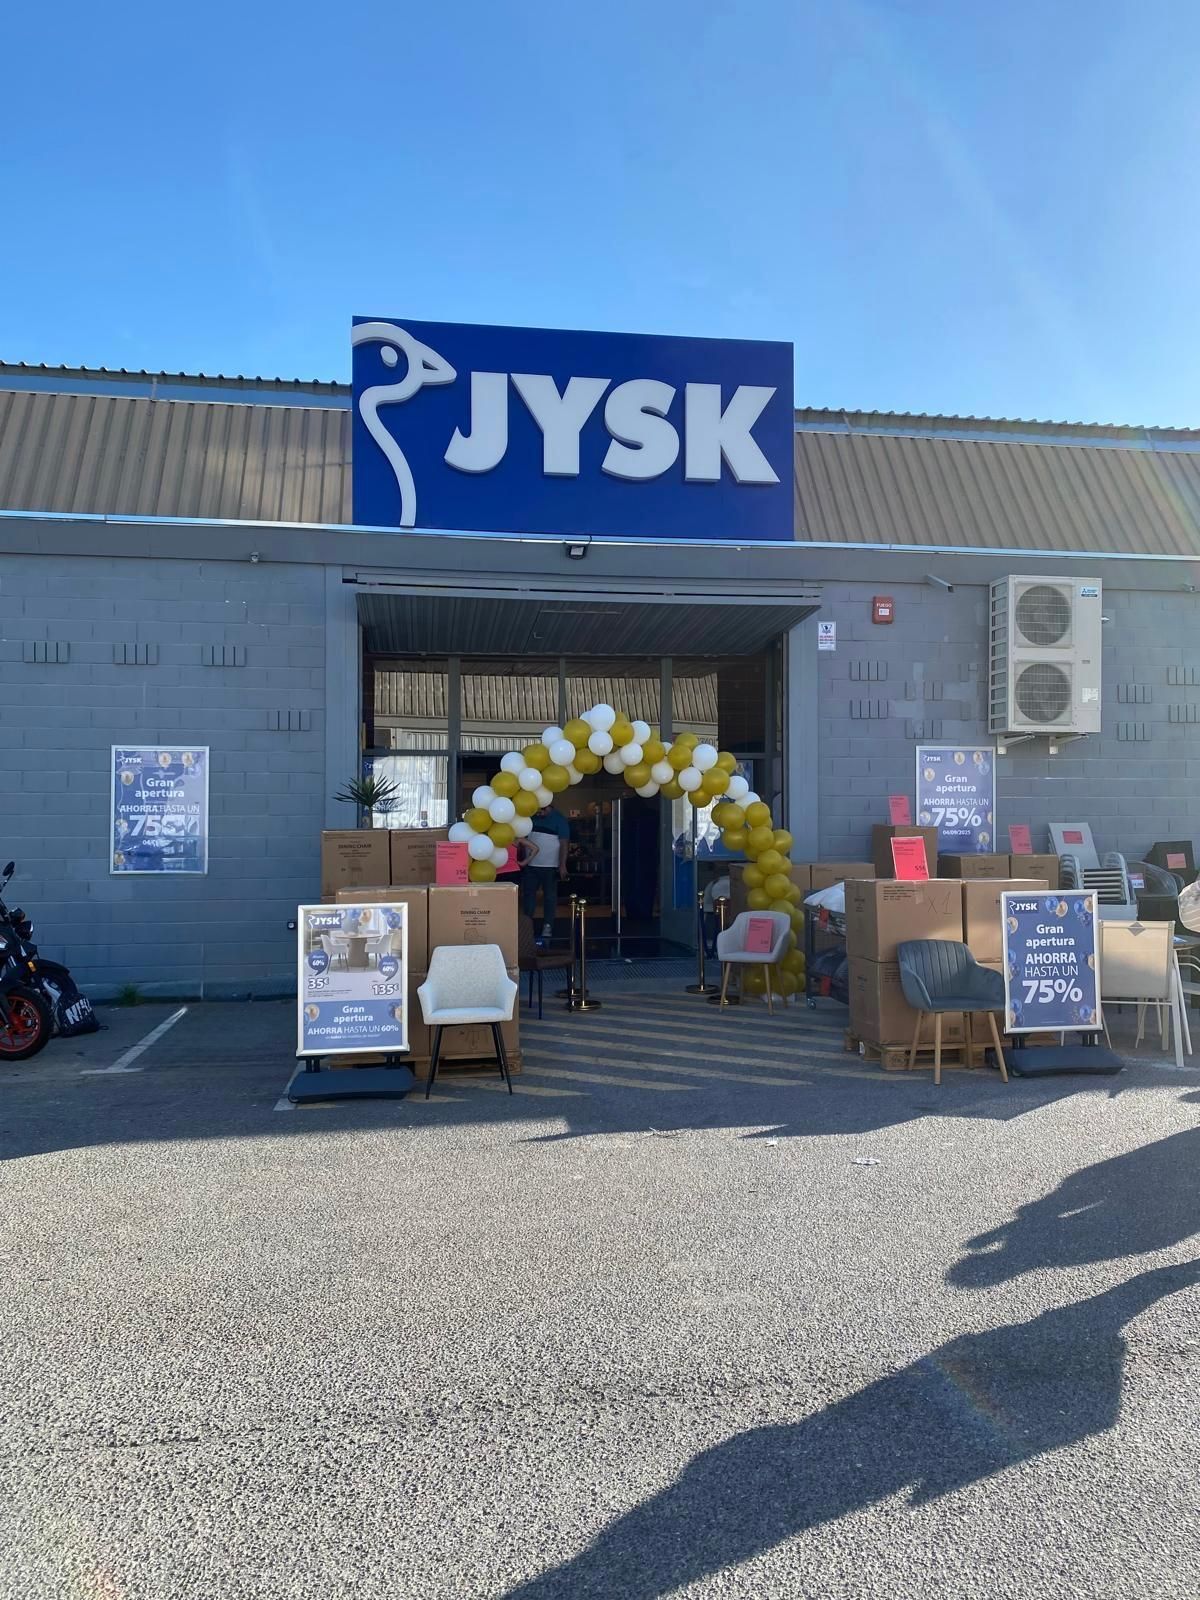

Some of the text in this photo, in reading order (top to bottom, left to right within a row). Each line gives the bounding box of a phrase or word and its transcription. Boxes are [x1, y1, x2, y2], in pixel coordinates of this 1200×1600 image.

[444, 371, 781, 485] JYSK
[146, 777, 174, 787] Gran
[945, 774, 968, 783] Gran
[135, 789, 185, 800] apertura
[936, 784, 977, 794] apertura
[923, 798, 989, 806] AHORRA HASTA UN
[119, 804, 160, 813] AHORRA
[160, 804, 186, 813] HASTA
[931, 807, 982, 827] 75%
[1015, 902, 1038, 911] JYSK
[315, 916, 340, 925] JYSK
[1036, 924, 1064, 934] Gran
[1026, 937, 1075, 949] apertura
[1025, 952, 1077, 965] AHORRA
[1025, 965, 1079, 977] HASTA UN
[307, 978, 329, 989] 35€
[371, 983, 399, 996] 135€
[1022, 979, 1083, 1004] 75%
[342, 1005, 365, 1014] Gran
[333, 1014, 374, 1025] apertura
[307, 1024, 399, 1036] AHORRA HASTA UN 60%
